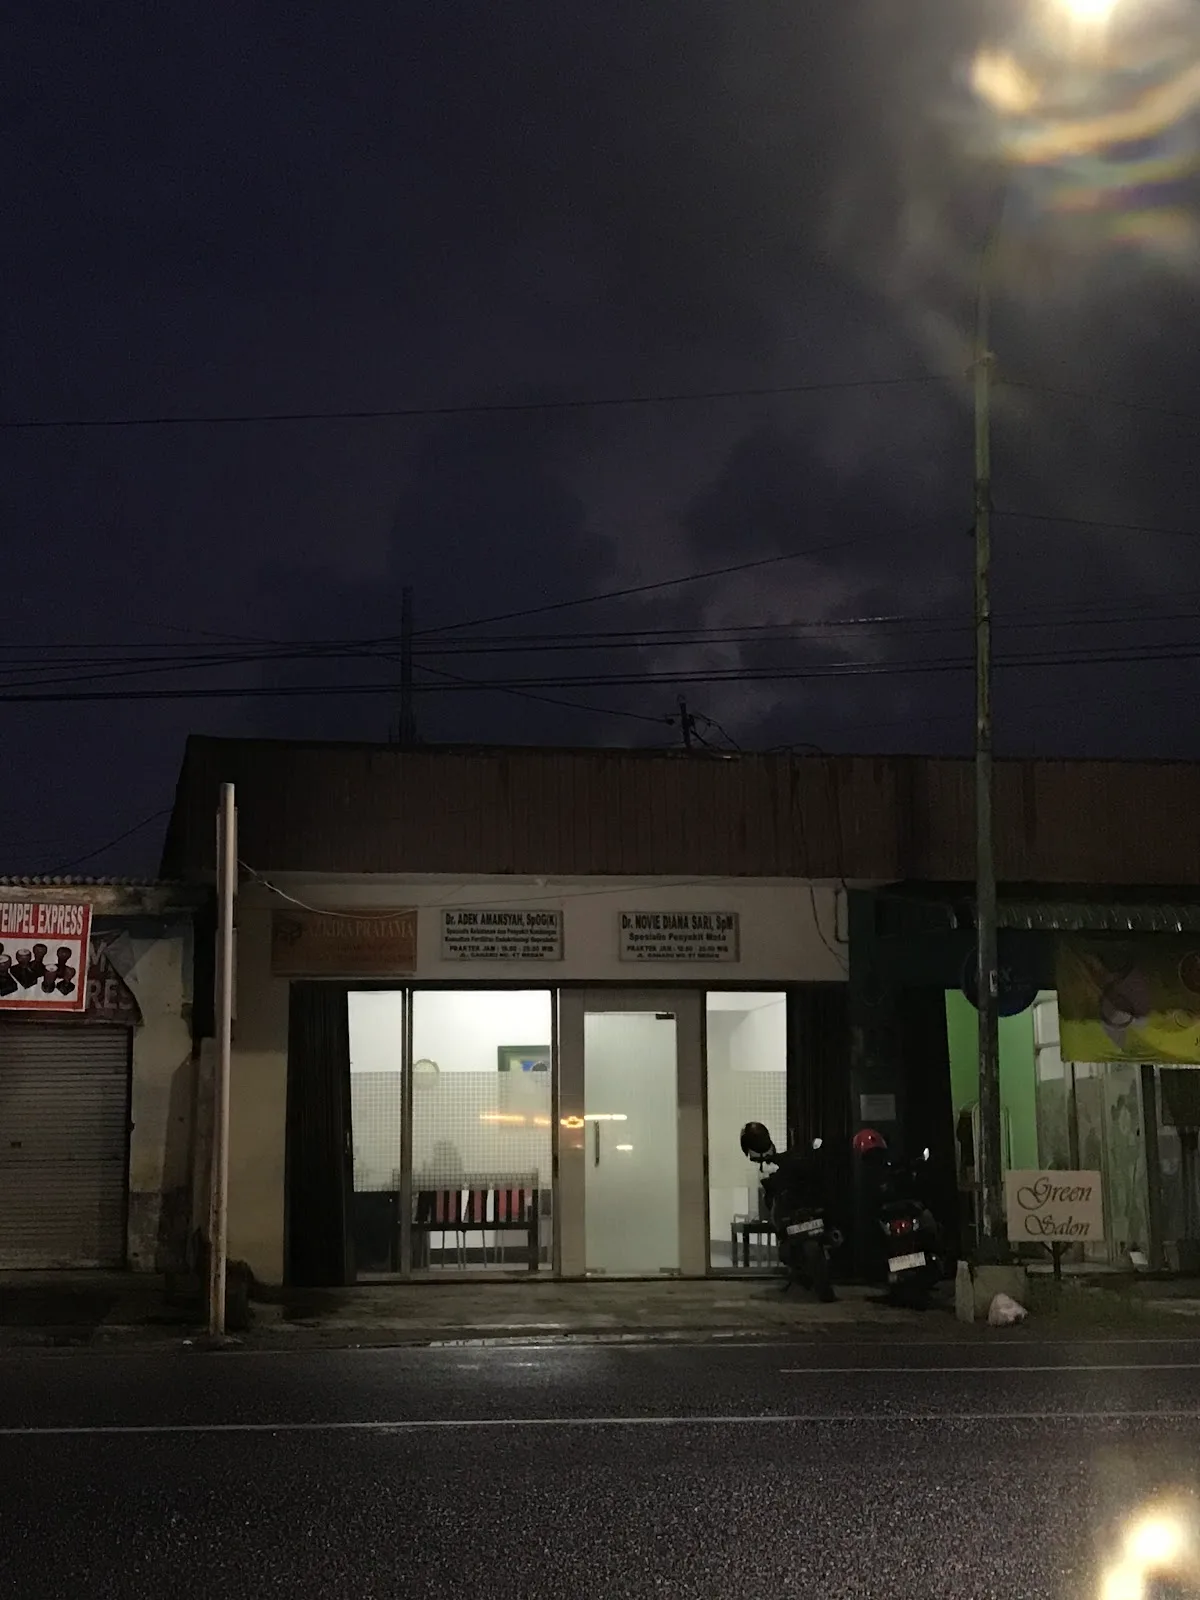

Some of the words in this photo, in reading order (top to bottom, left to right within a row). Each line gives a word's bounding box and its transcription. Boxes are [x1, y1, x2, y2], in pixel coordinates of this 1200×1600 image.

[37, 903, 84, 937] EXPRESS
[446, 913, 456, 925] Dr.
[458, 913, 478, 925] ADEK
[481, 913, 524, 927] AMANSYAH,
[526, 913, 557, 928] SpOG(K)
[622, 914, 633, 929] Dr.
[635, 914, 661, 930] NOVIE
[662, 915, 689, 930] DIANA
[691, 915, 715, 932] SARI,
[716, 915, 733, 933] SpM
[629, 932, 667, 942] Spesialis
[668, 933, 704, 942] Penyakit
[706, 933, 727, 941] Mata
[1017, 1176, 1092, 1211] Green
[1024, 1214, 1091, 1237] Salon
